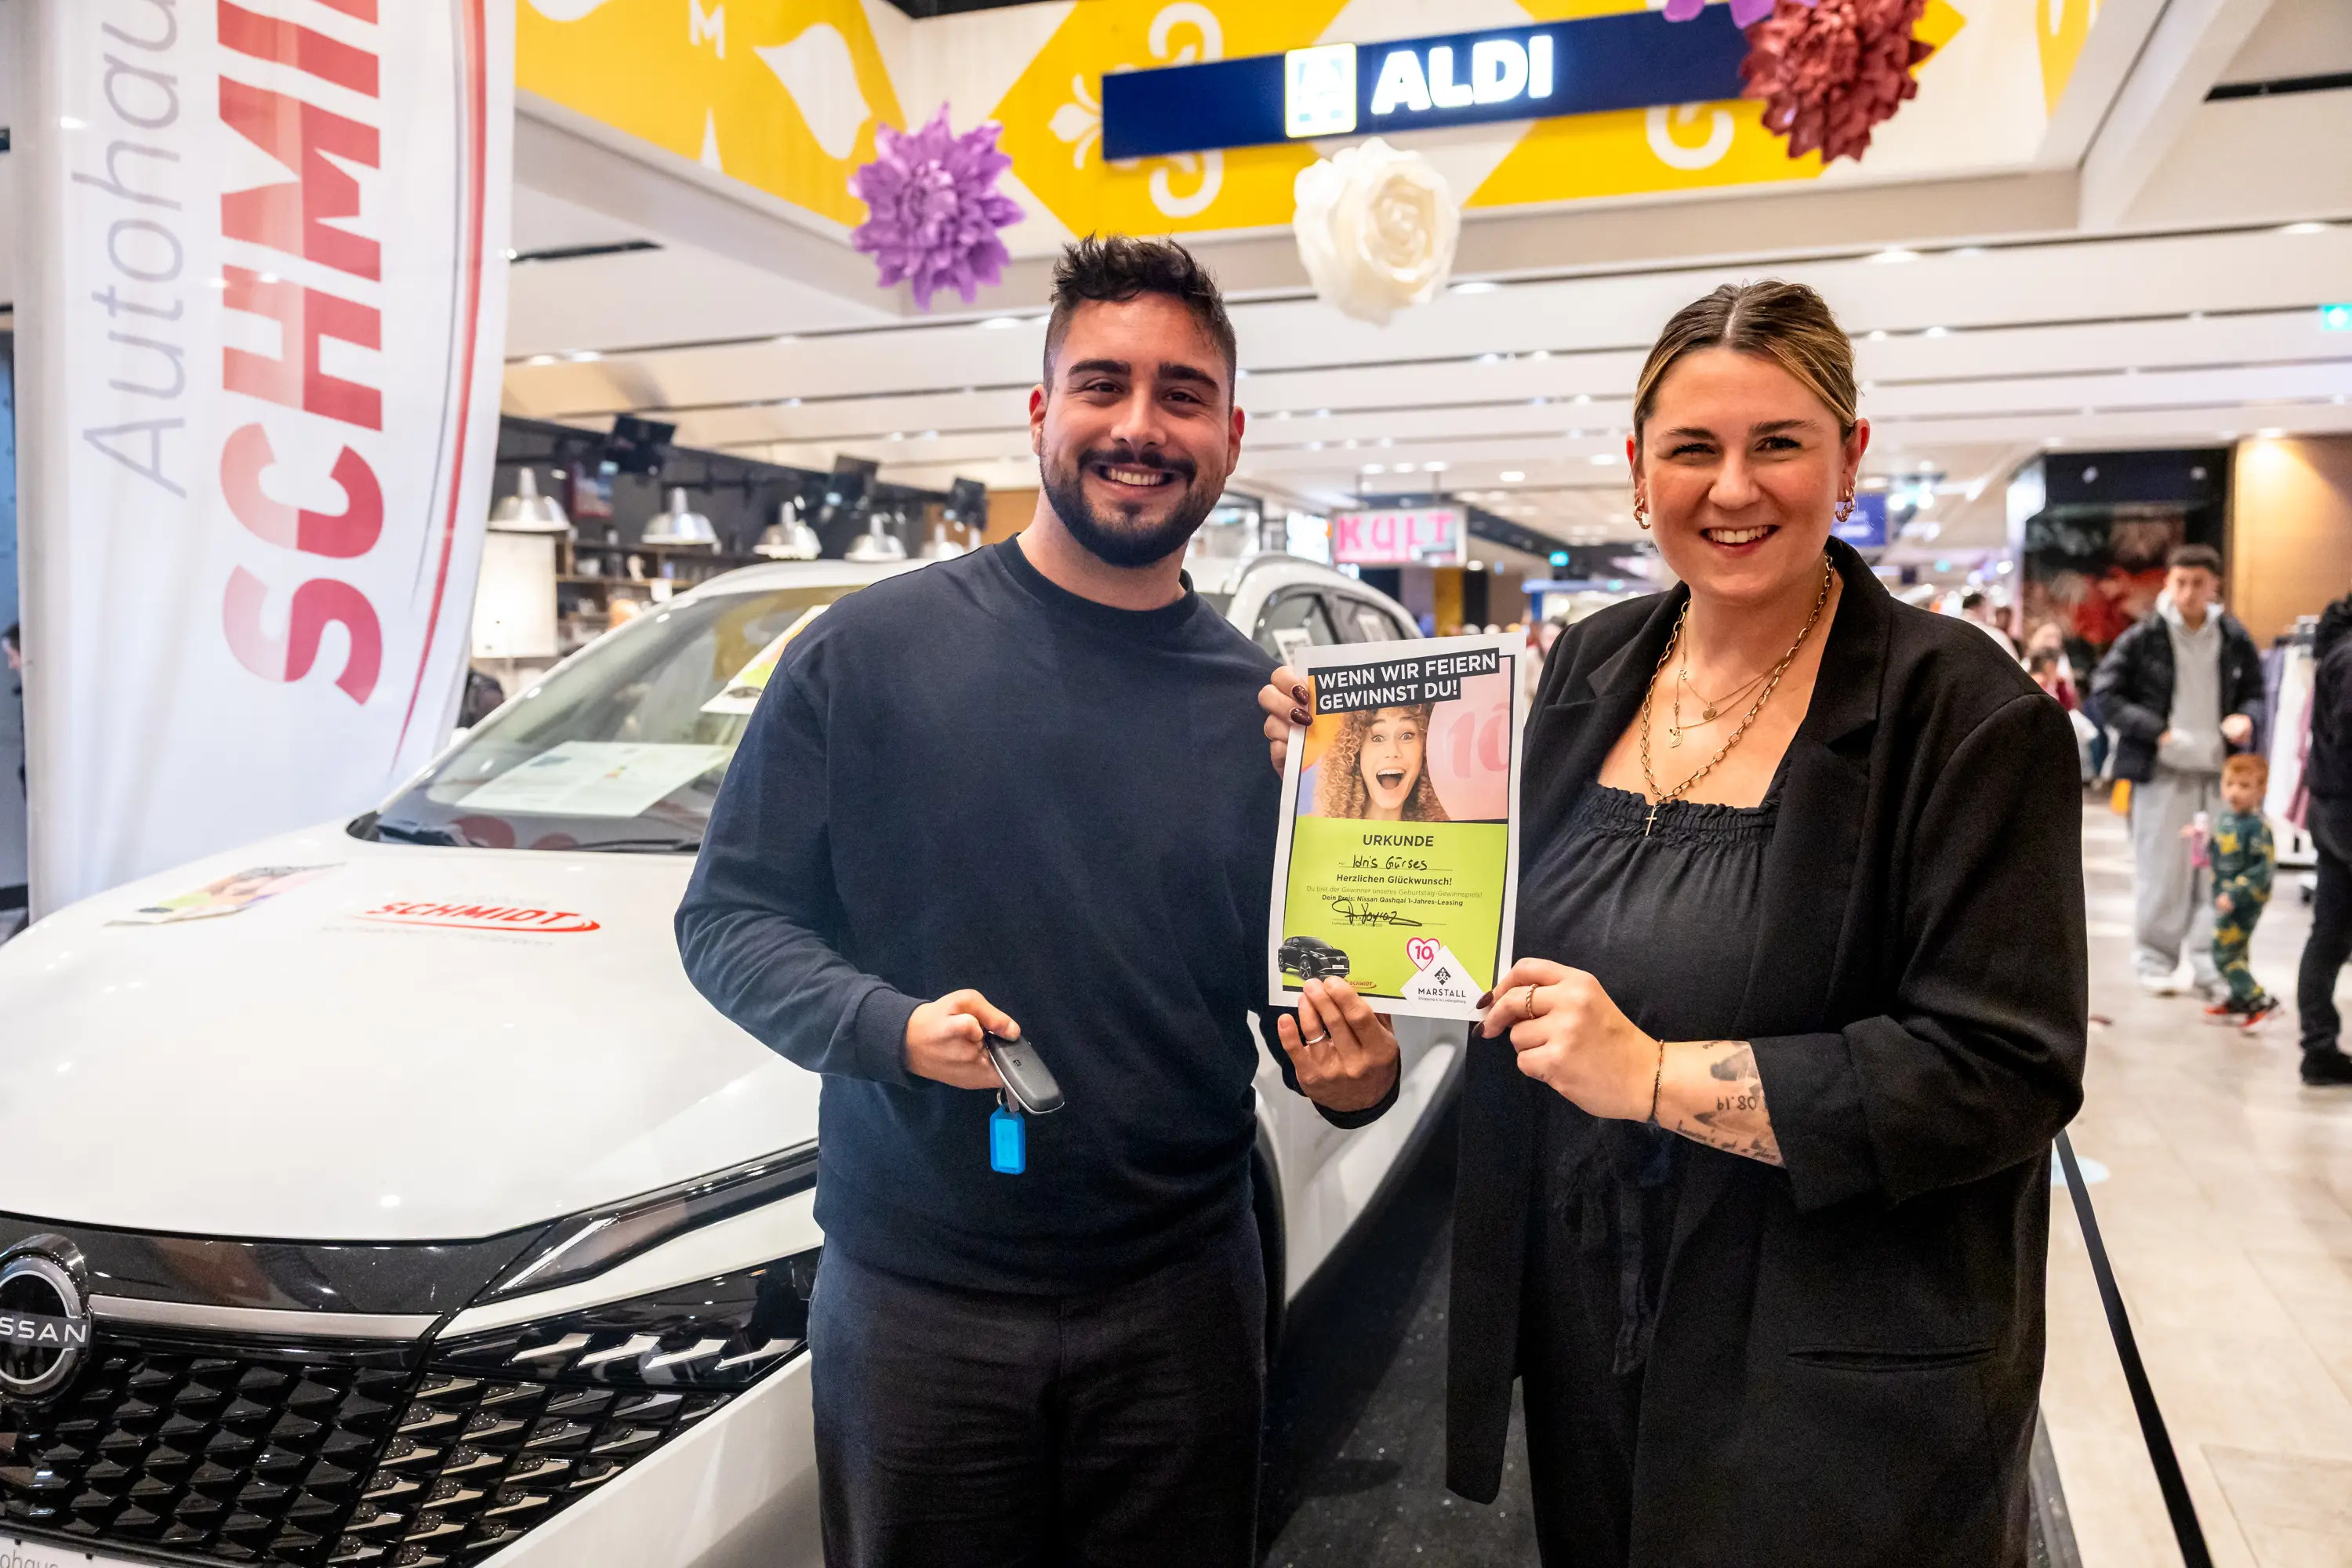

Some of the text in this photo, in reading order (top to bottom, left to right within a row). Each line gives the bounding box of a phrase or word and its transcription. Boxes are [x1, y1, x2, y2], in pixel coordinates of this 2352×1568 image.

[1370, 34, 1553, 115] ALDI
[217, 0, 383, 706] SCHMI
[1338, 512, 1454, 550] KULT
[1318, 653, 1496, 690] WENN WIR FEIERN
[1319, 680, 1457, 710] GEWINNST DU!
[1363, 834, 1434, 847] URKUNDE
[1337, 874, 1452, 885] Herzlichen Glückwunsch!
[365, 902, 581, 924] SCHMIDT
[1415, 946, 1432, 960] 10
[1417, 988, 1466, 997] MARSTALL
